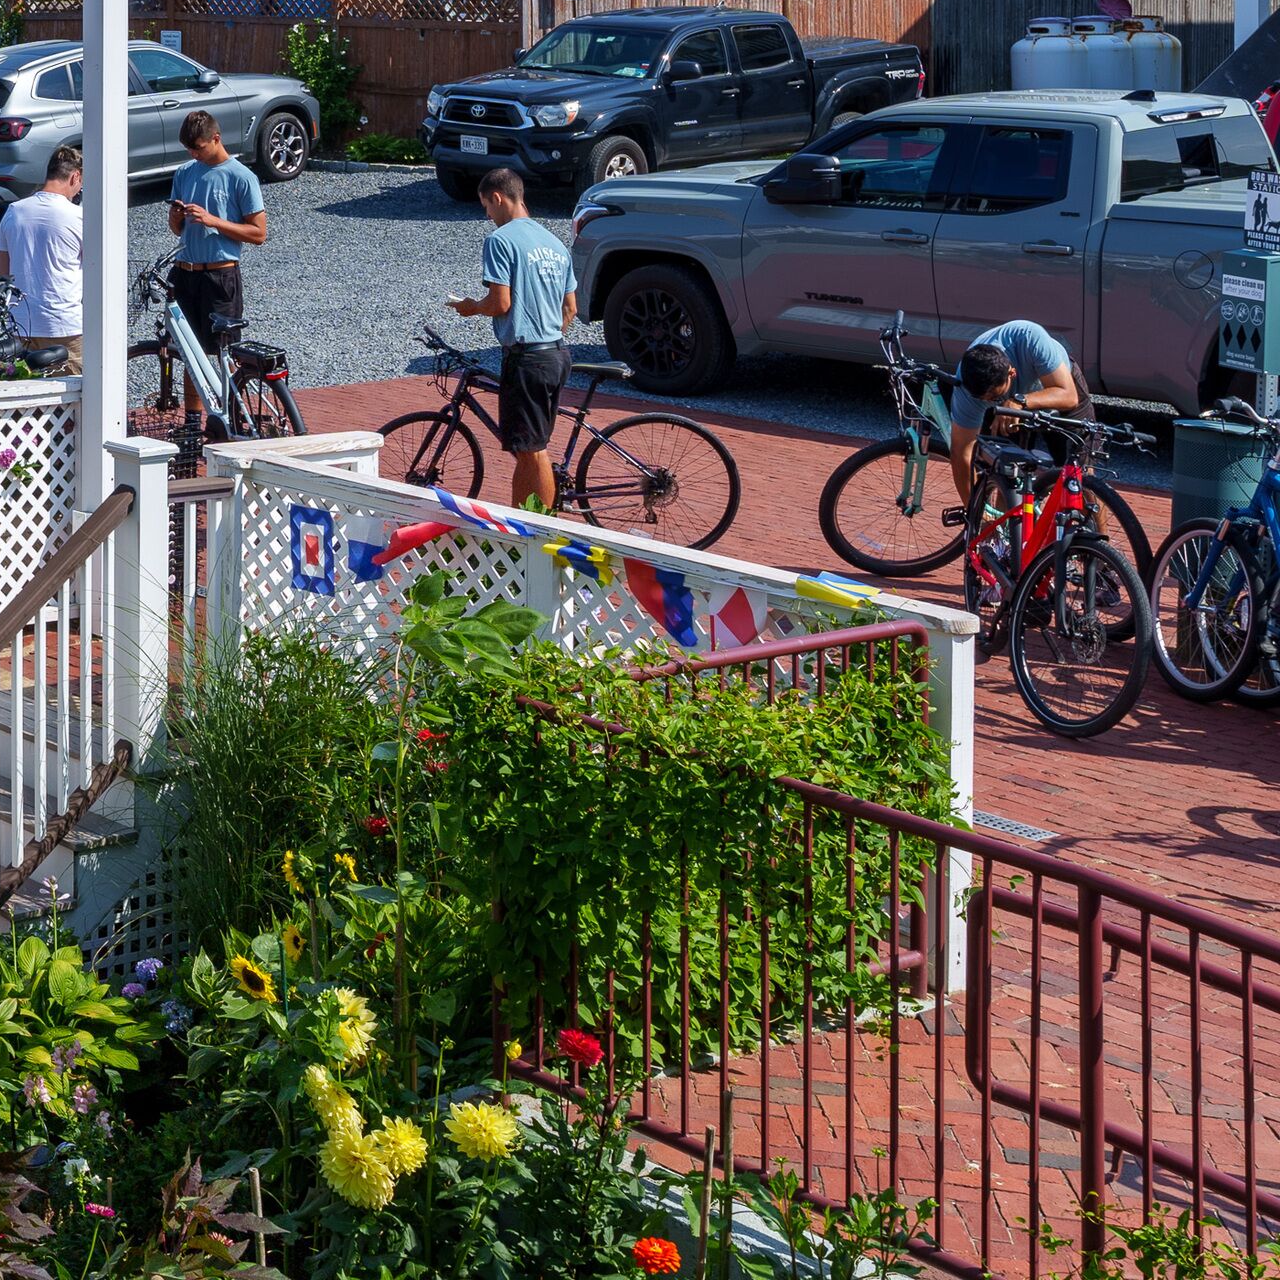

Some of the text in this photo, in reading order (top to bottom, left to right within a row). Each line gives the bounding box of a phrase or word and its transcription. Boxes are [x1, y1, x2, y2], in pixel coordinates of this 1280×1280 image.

[1251, 171, 1280, 183] DOG WA
[1247, 231, 1280, 242] PLEASE CLEAN
[1247, 239, 1262, 248] AFTER
[1223, 276, 1264, 291] please clean up
[803, 291, 864, 304] TUNDRA
[1225, 285, 1263, 299] after your dog
